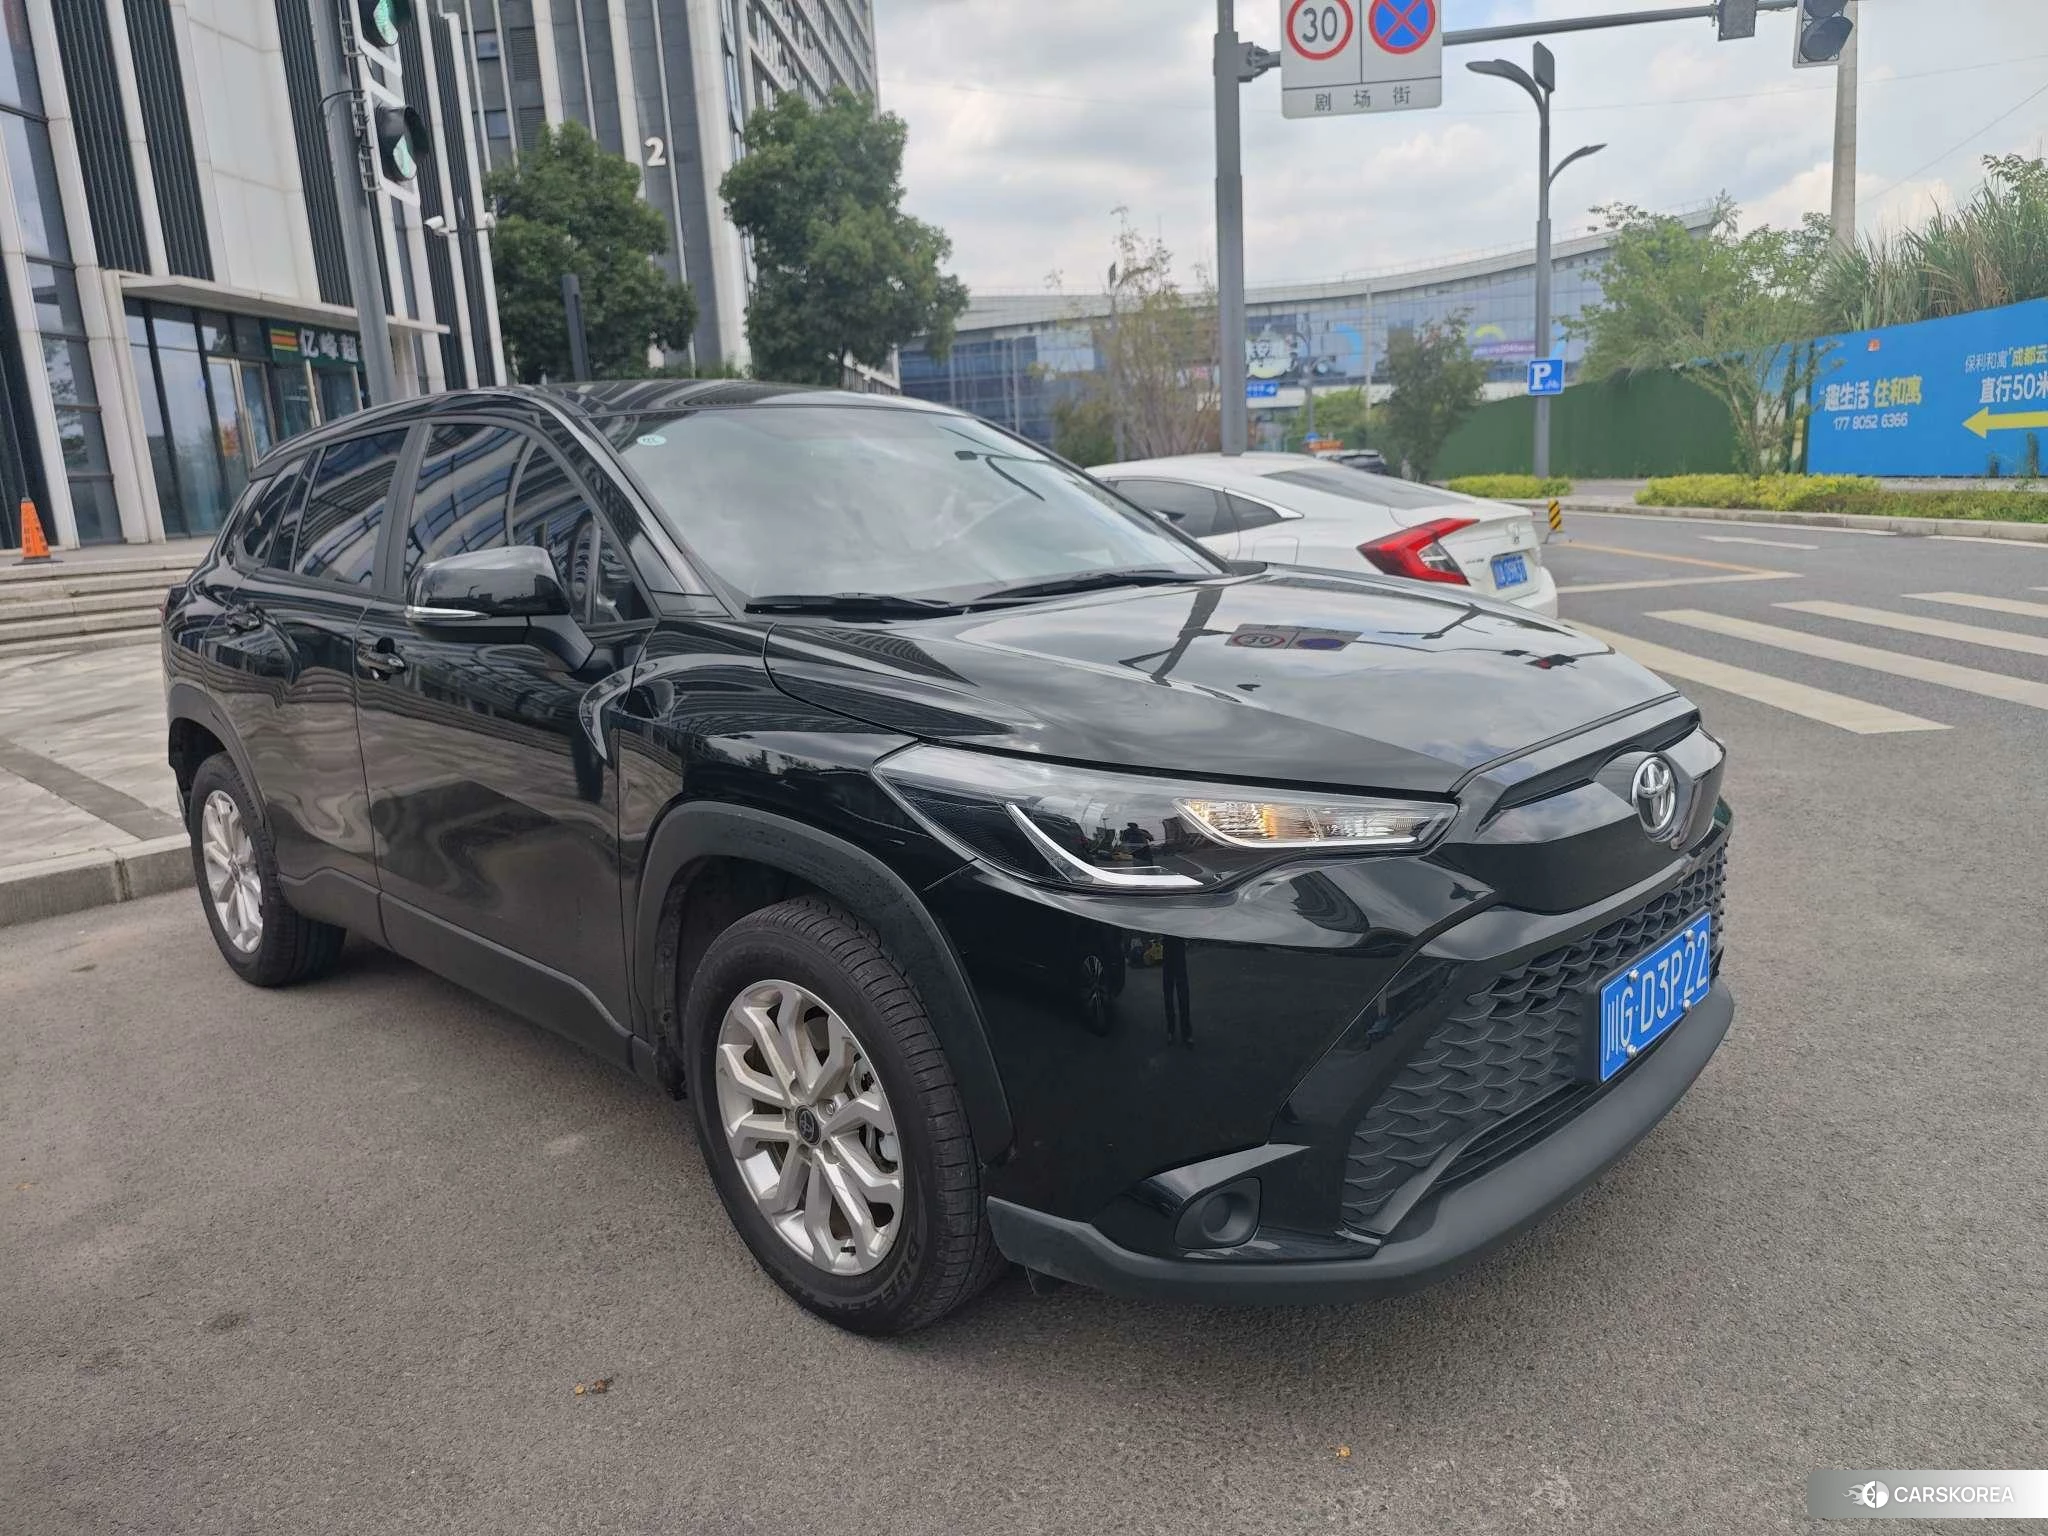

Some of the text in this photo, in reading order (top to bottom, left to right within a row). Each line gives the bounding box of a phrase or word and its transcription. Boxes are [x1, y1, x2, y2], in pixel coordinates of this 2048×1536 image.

[1302, 6, 1337, 43] 30
[645, 137, 666, 167] 2
[1531, 362, 1552, 391] P
